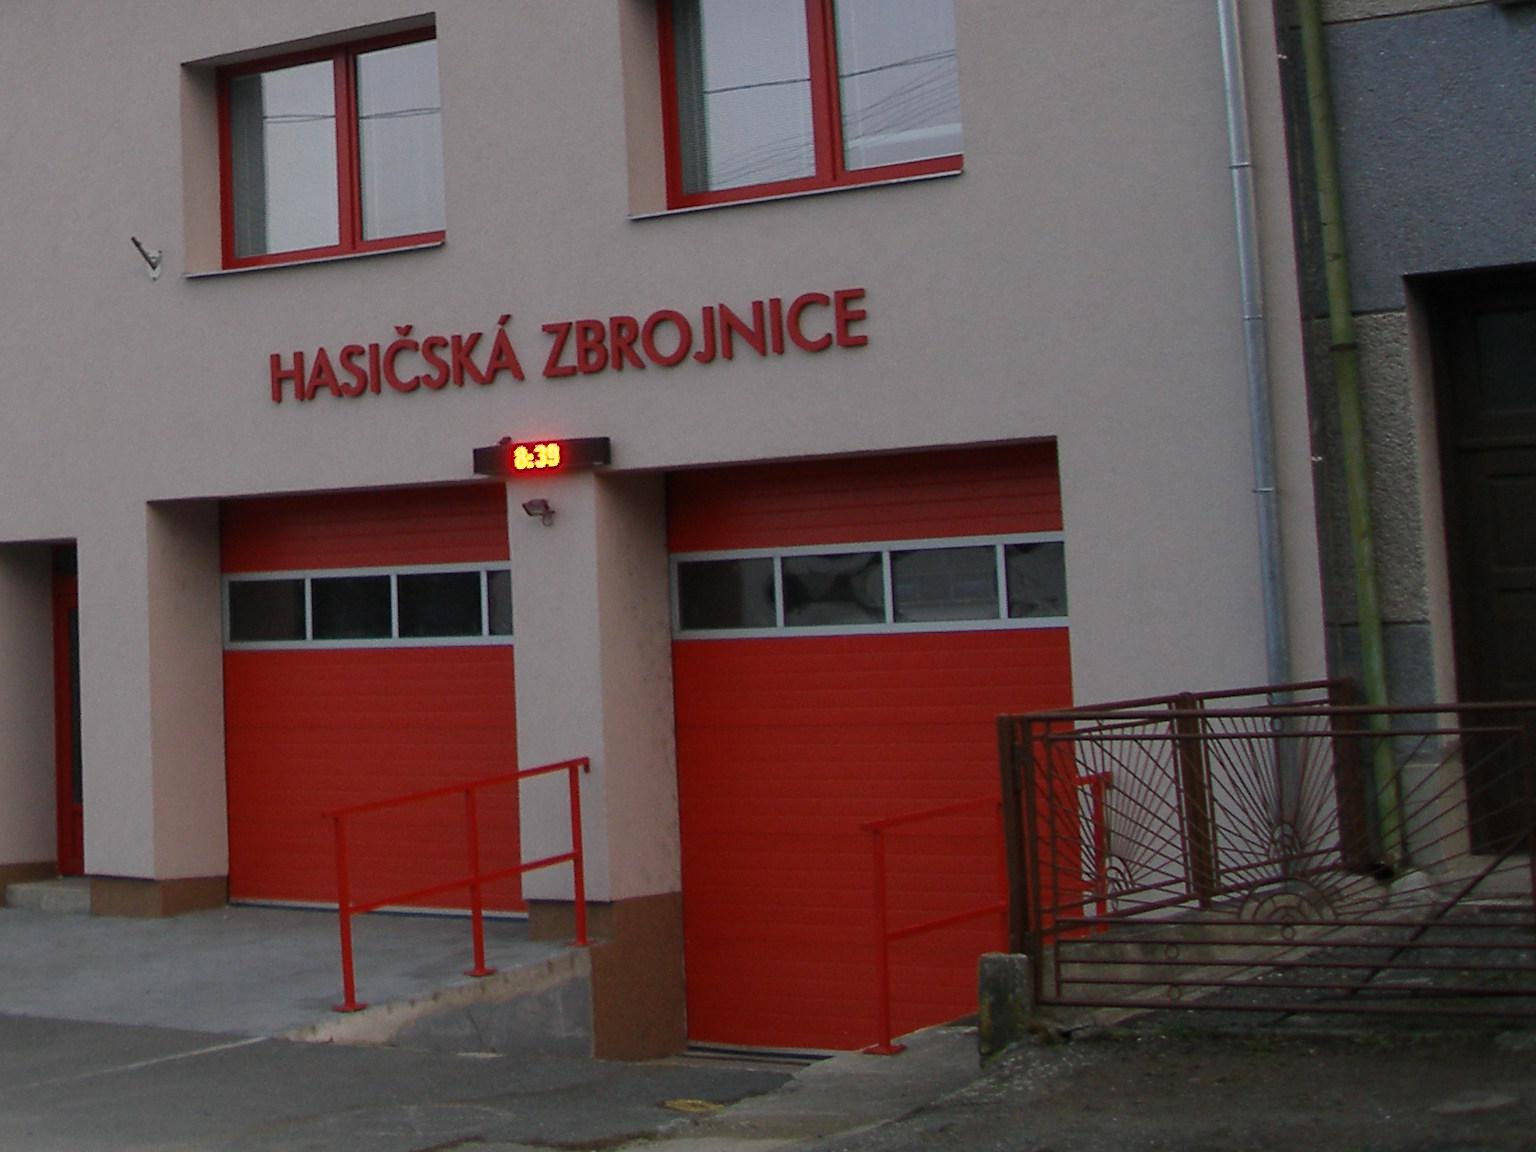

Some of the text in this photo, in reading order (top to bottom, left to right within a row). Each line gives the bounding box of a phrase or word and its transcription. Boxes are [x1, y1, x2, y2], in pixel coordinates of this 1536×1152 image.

[270, 288, 868, 403] HASIČSKÁ ZBROJNICE
[513, 443, 560, 469] 8:39
